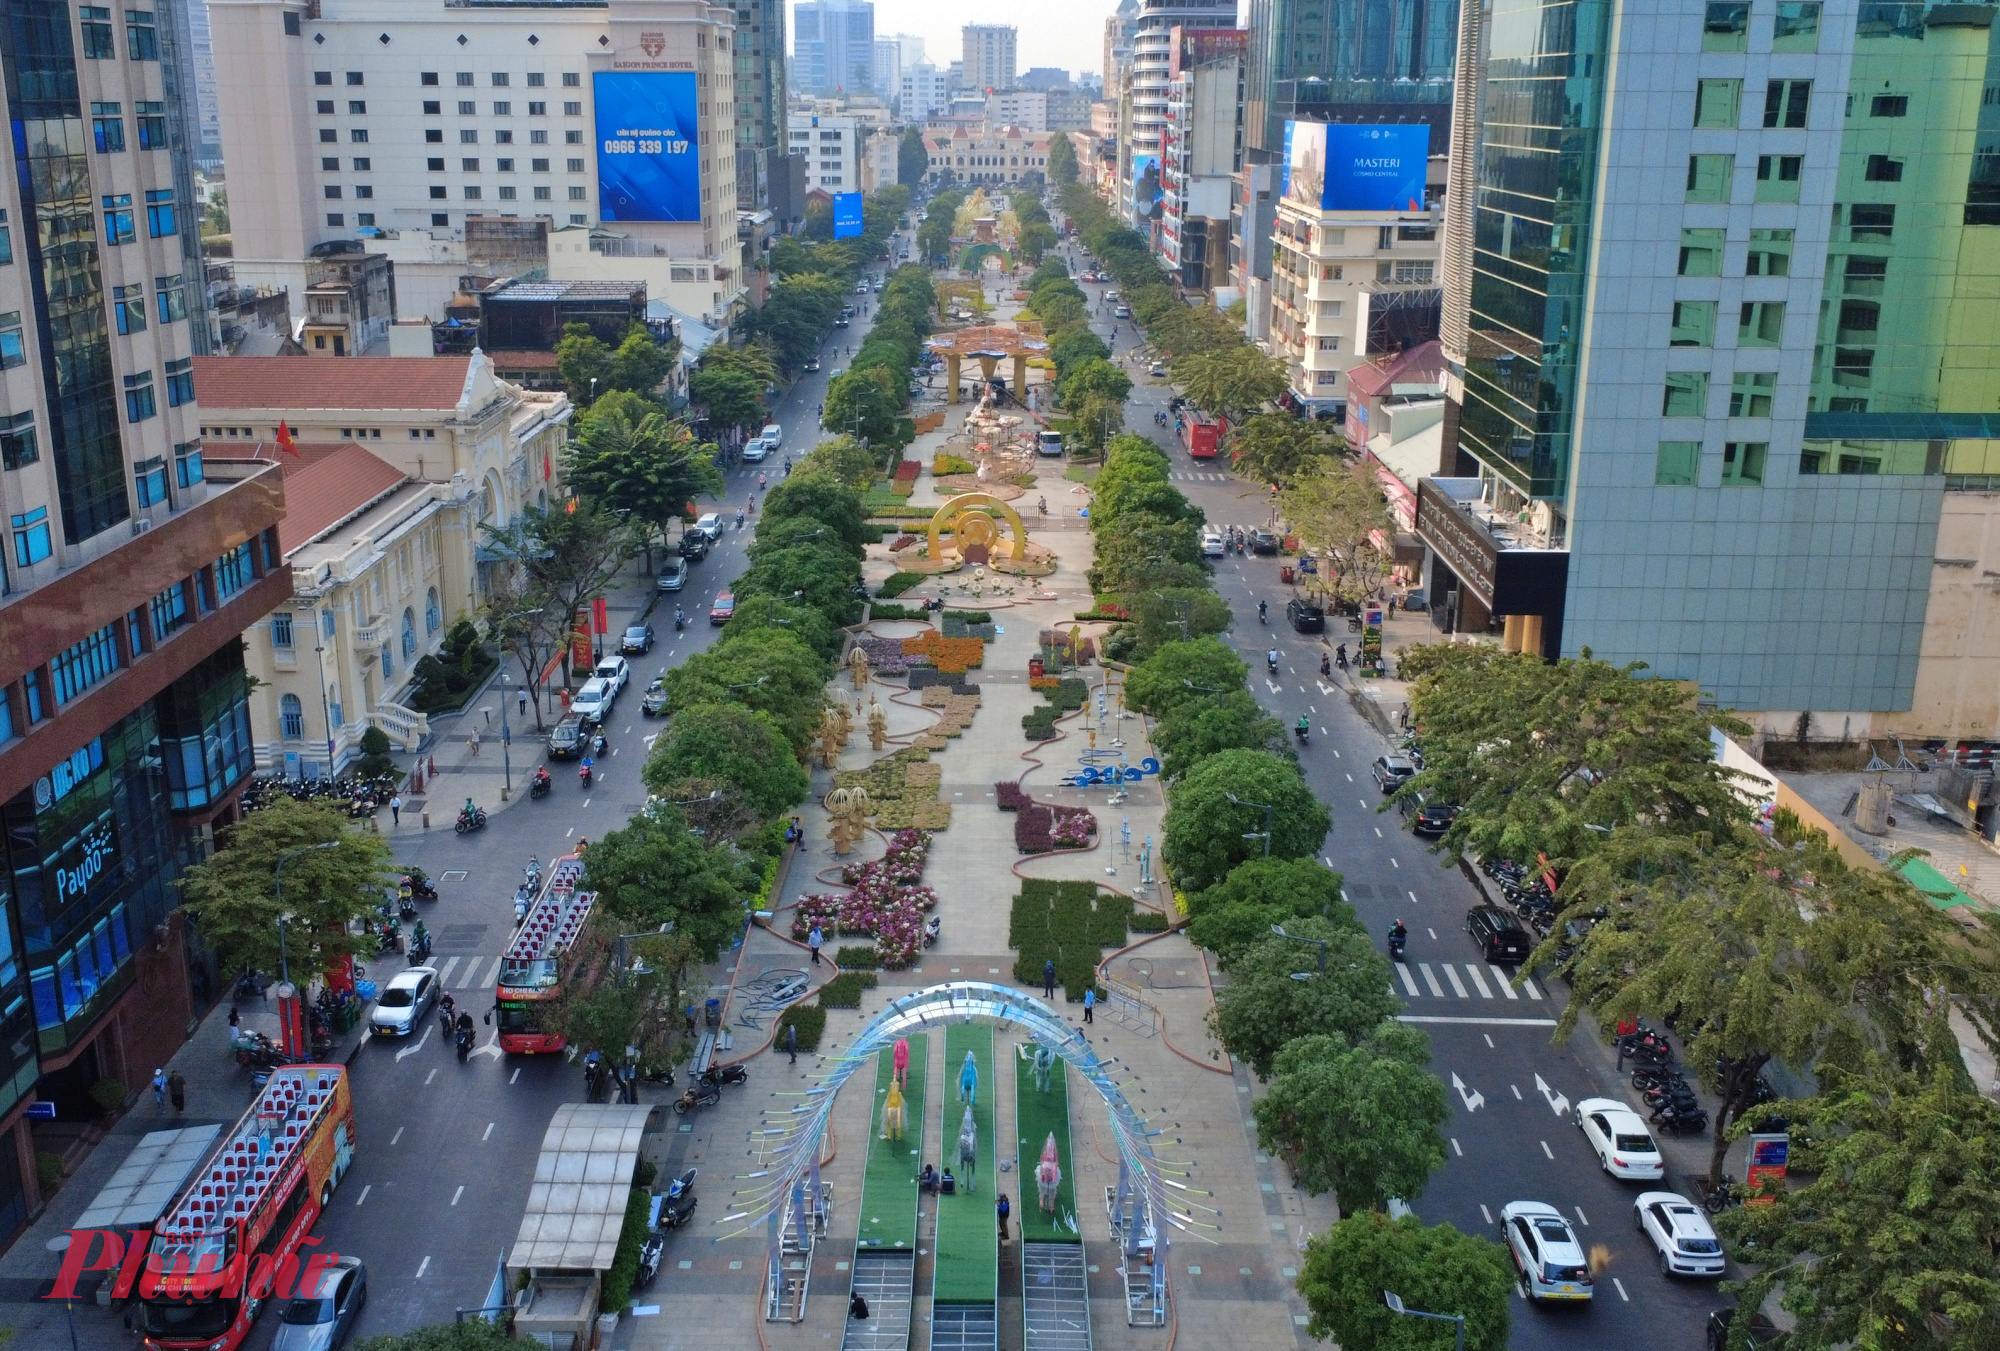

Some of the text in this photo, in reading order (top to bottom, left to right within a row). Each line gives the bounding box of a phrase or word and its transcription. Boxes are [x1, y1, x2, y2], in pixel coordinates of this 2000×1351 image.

[613, 61, 694, 69] SAIGON PRINCE HOTEL
[604, 140, 689, 154] 0966 339 197
[1353, 158, 1401, 168] MASTERI
[56, 849, 103, 905] Payoo
